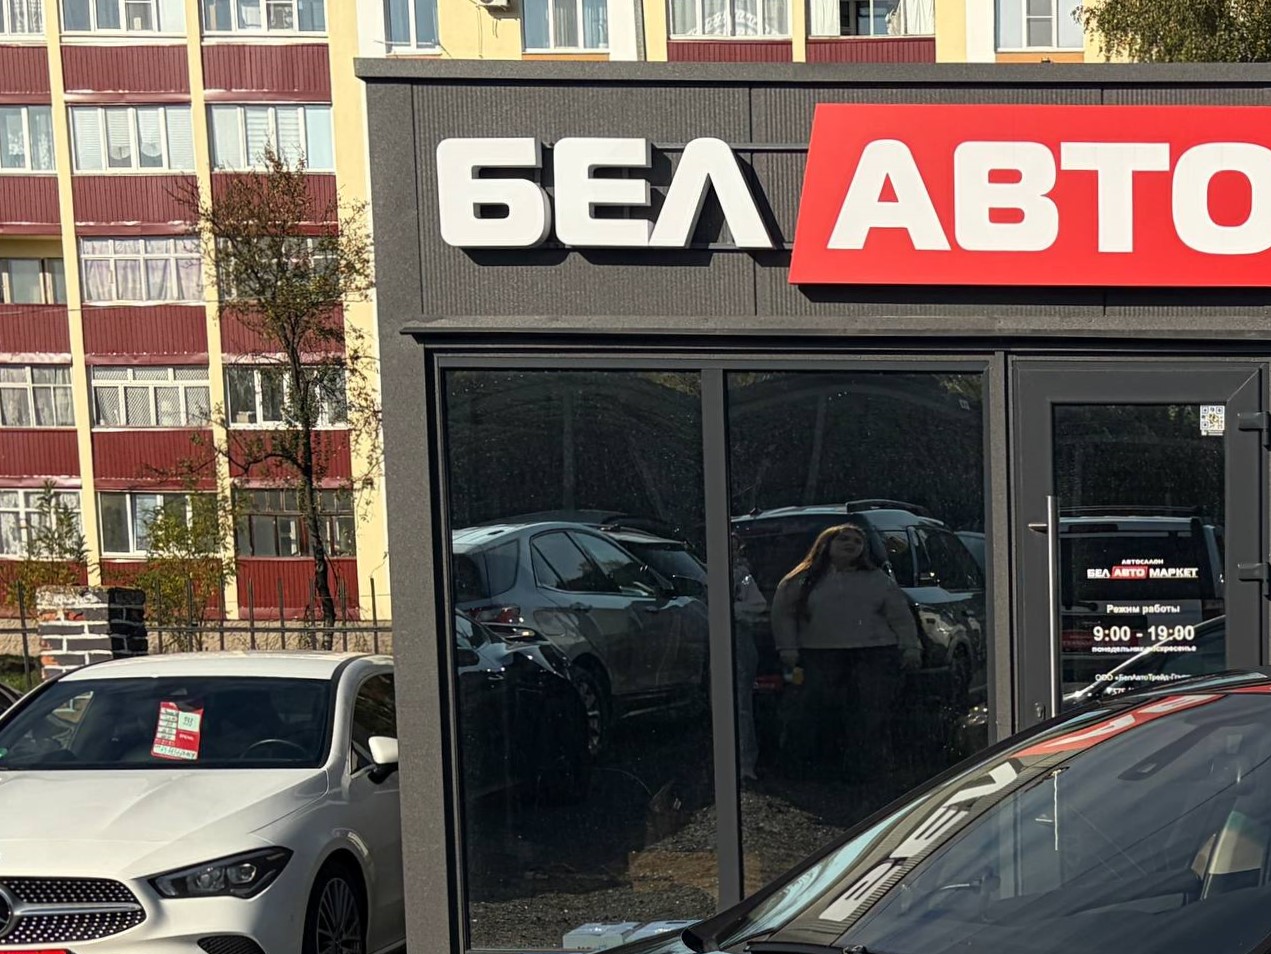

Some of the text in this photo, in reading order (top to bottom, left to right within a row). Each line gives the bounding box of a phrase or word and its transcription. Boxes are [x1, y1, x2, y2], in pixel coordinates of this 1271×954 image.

[436, 137, 774, 248] БЕЛ
[1087, 568, 1199, 578] БЕЛ АВТО МАРКЕТ
[1106, 604, 1181, 615] Режим работы
[1093, 625, 1131, 641] 9:00
[1147, 625, 1195, 641] 19:00
